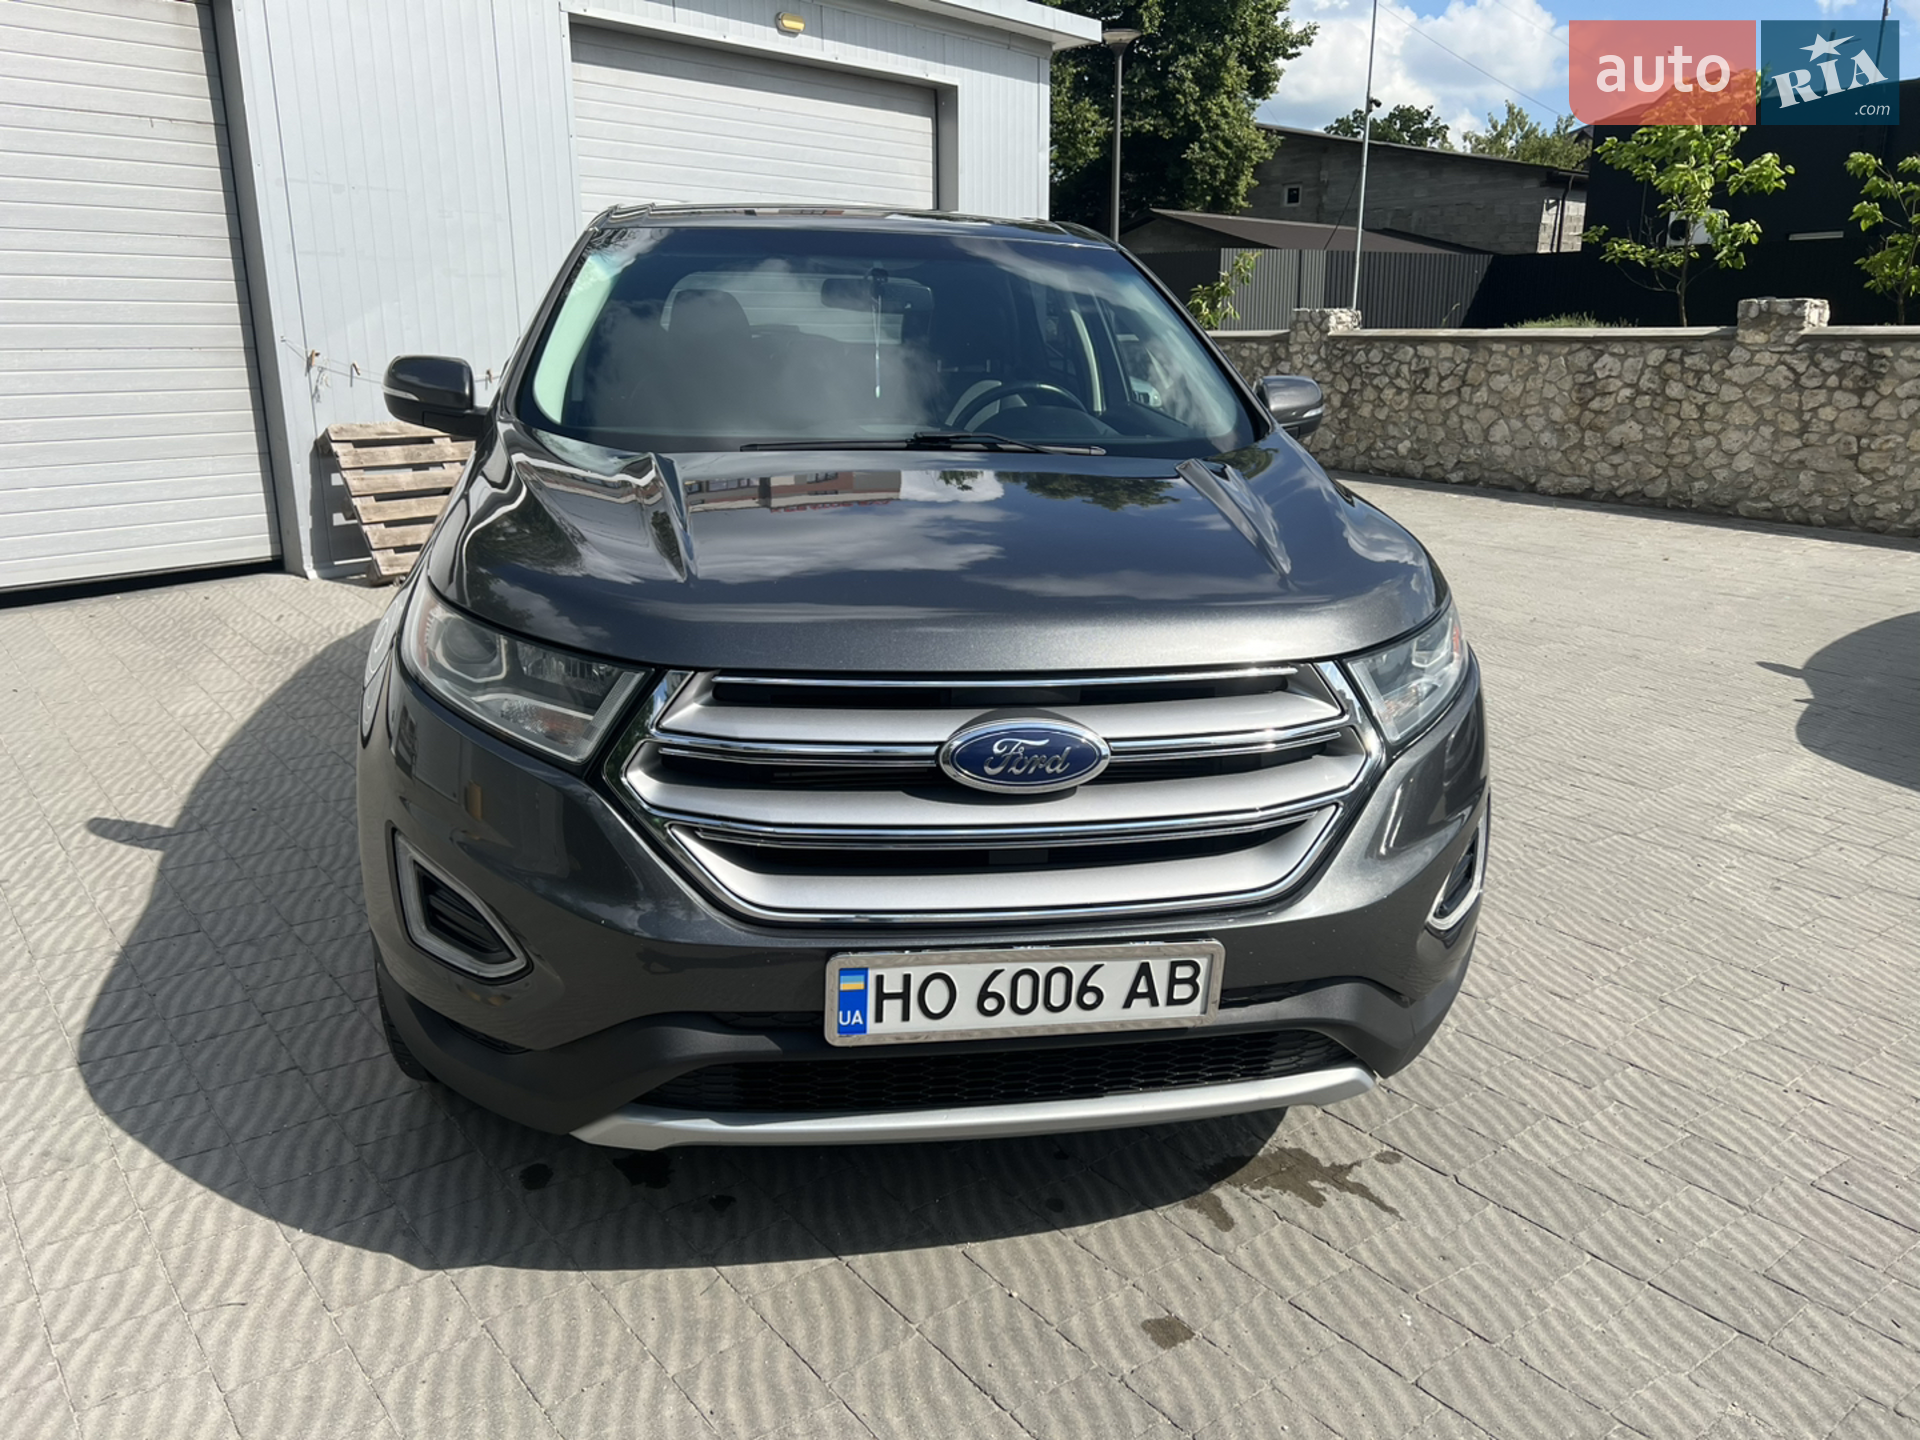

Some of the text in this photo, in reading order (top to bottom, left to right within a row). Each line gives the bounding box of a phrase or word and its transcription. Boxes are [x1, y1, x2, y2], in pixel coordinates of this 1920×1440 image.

[983, 738, 1072, 776] Ford
[874, 959, 1202, 1024] HO 6006 AB
[838, 1010, 864, 1026] UA
